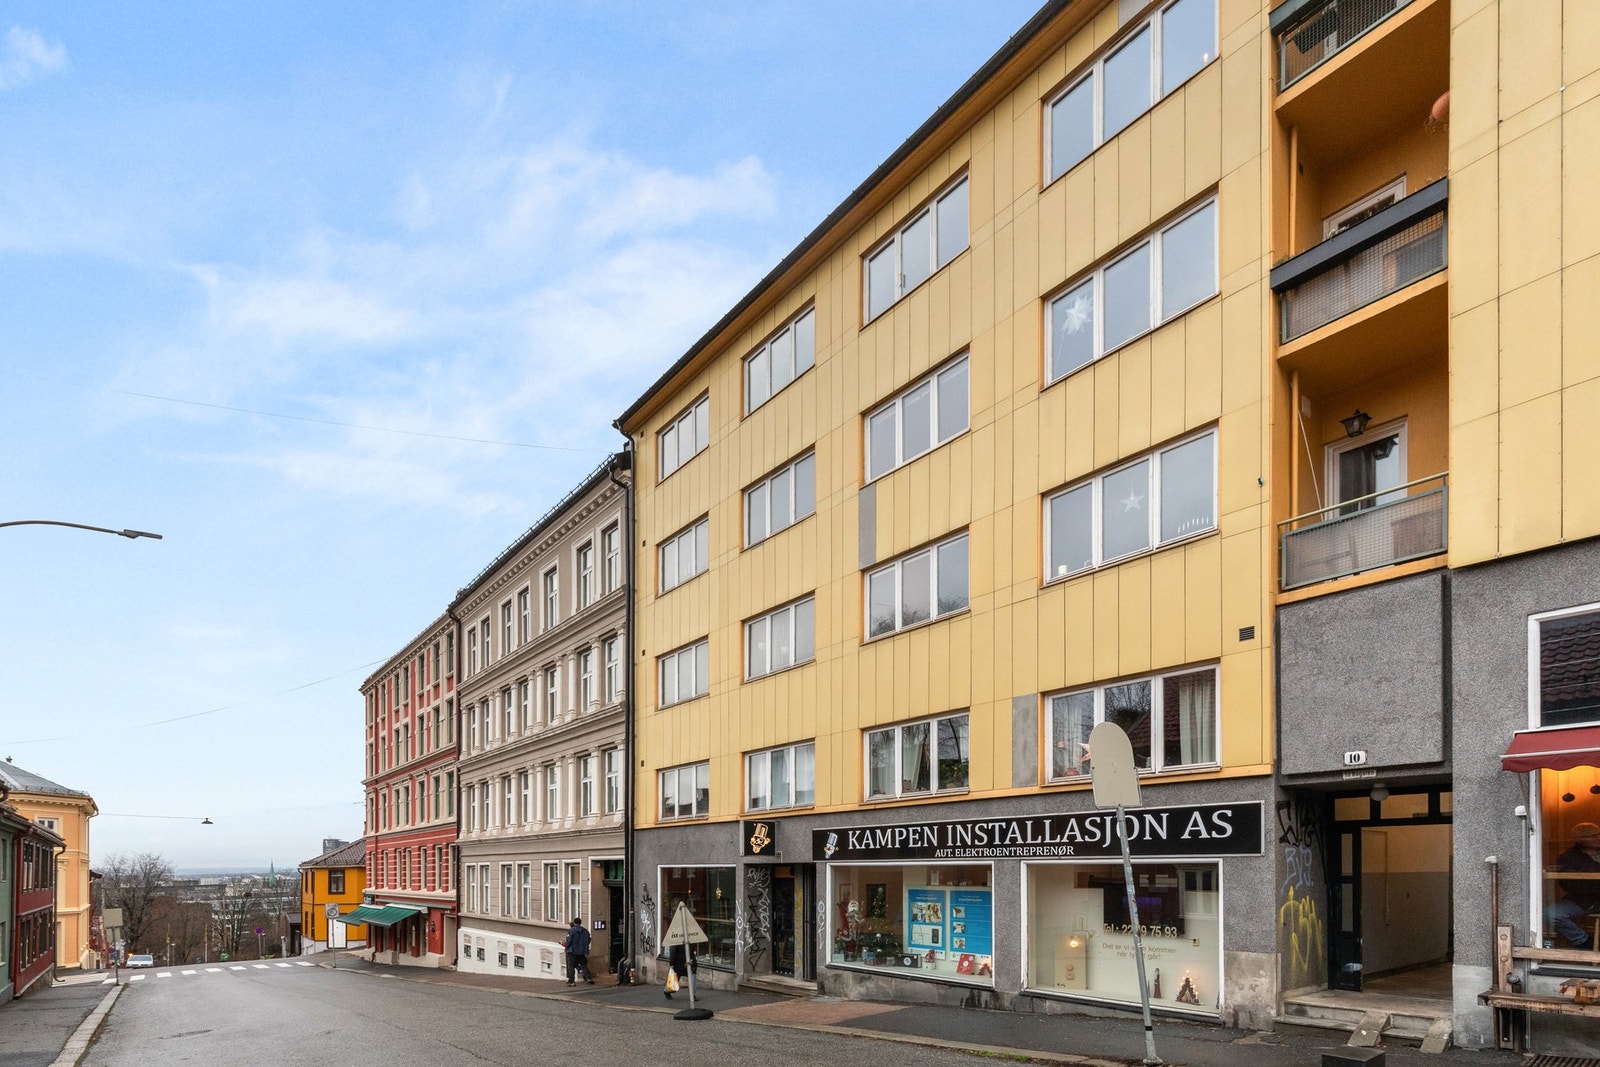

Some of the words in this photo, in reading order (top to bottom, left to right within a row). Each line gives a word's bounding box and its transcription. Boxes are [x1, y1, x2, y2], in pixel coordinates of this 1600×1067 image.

[1349, 753, 1360, 764] 10
[848, 825, 938, 850] KAMPEN
[946, 813, 1169, 848] INSTALLASJON
[1180, 809, 1233, 839] AS
[935, 848, 954, 857] AUT.
[955, 845, 1075, 857] ELEKTROENTREPRENØR
[1150, 925, 1162, 938] 75
[1165, 926, 1178, 939] 93
[1148, 945, 1177, 954] kommer
